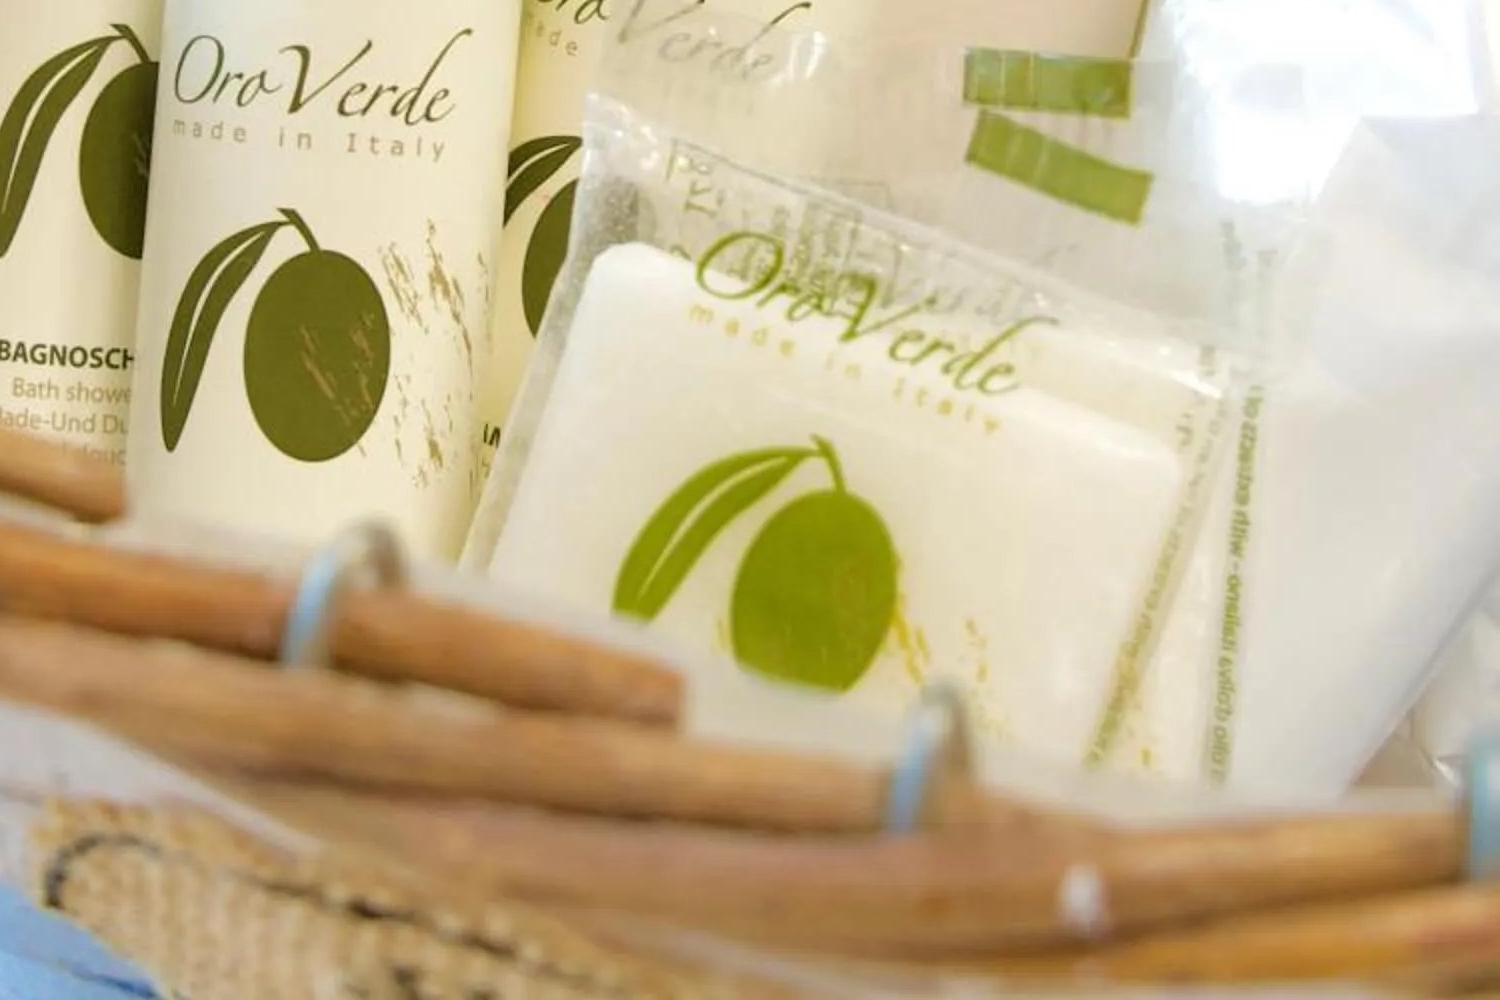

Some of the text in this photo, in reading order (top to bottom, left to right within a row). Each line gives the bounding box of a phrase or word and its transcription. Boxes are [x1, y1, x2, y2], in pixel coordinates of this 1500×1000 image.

[172, 117, 446, 163] made in Italy
[11, 376, 60, 400] Bath
